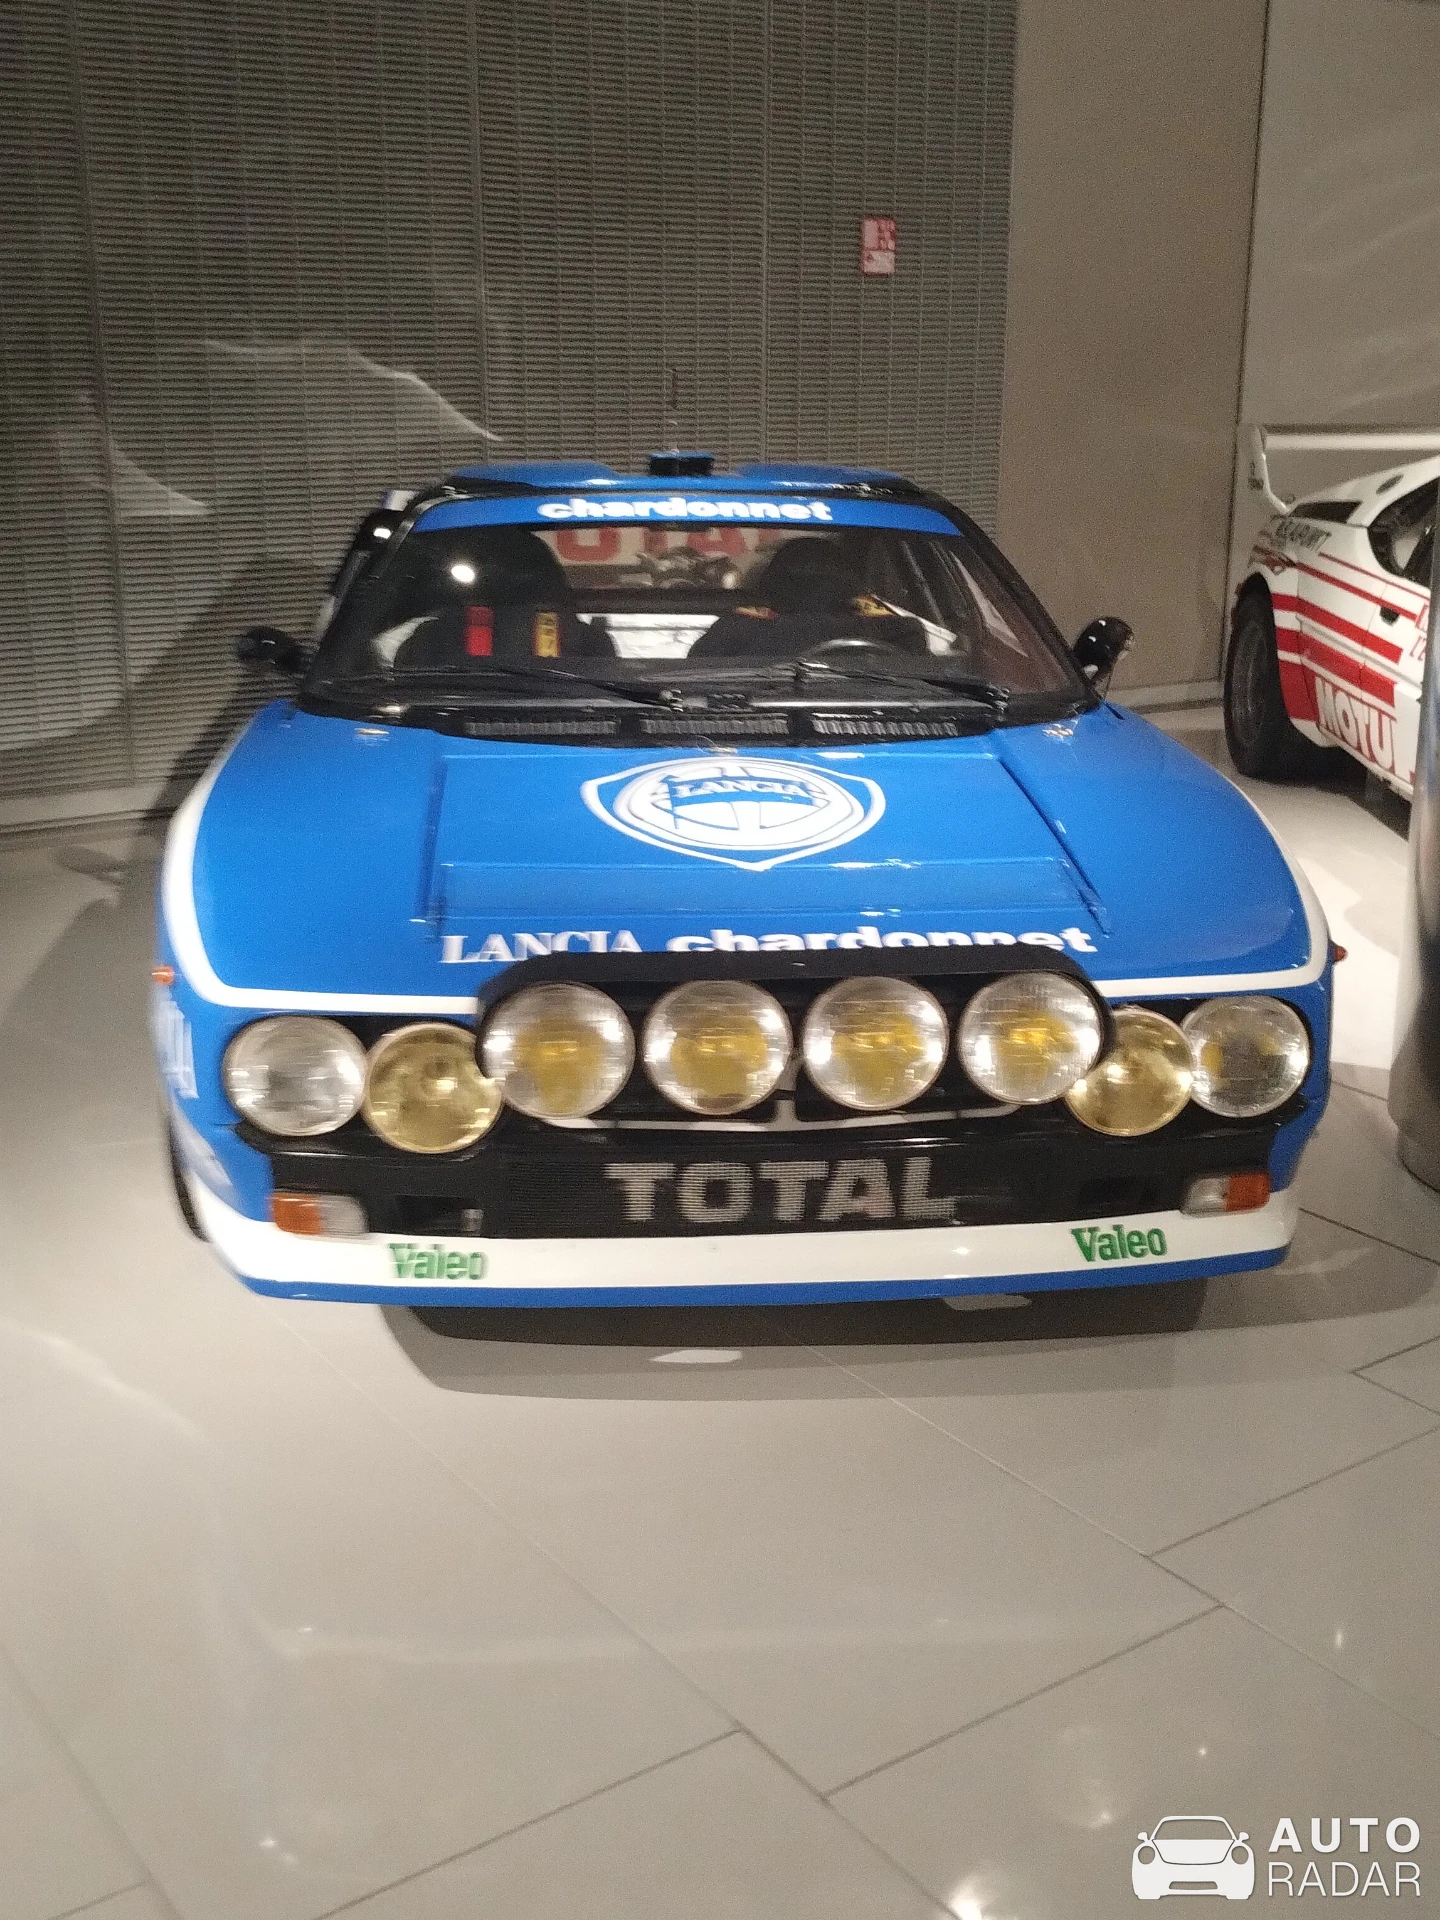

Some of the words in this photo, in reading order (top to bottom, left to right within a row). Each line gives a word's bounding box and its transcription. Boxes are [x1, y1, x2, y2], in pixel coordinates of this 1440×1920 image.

[537, 497, 833, 520] chardonnet
[671, 780, 806, 799] LANCIA
[438, 930, 643, 963] LANCIA
[602, 1156, 957, 1222] TOTAL
[1070, 1224, 1167, 1262] Valeo
[388, 1243, 488, 1280] Valeo
